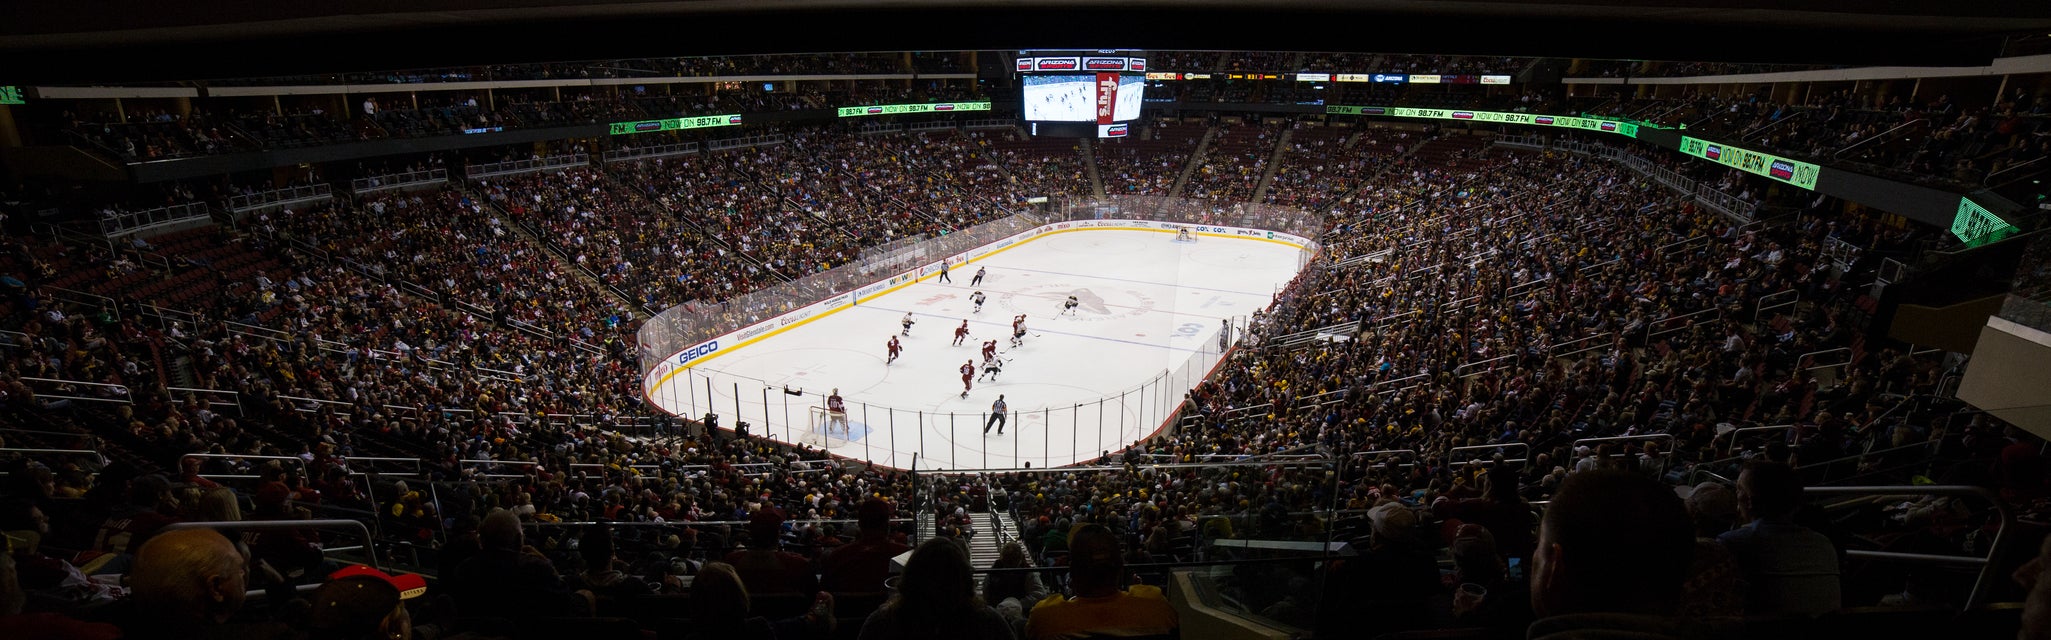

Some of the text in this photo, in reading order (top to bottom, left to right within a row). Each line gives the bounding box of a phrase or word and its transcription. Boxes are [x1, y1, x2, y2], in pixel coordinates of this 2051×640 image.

[684, 118, 695, 127] ON
[697, 117, 711, 126] 98.7
[712, 117, 722, 125] FM
[1556, 117, 1570, 125] NOW
[1772, 162, 1794, 172] ARIZONA
[1771, 168, 1791, 179] SPORTS
[1795, 165, 1818, 185] NOW
[680, 341, 718, 364] GEICO
